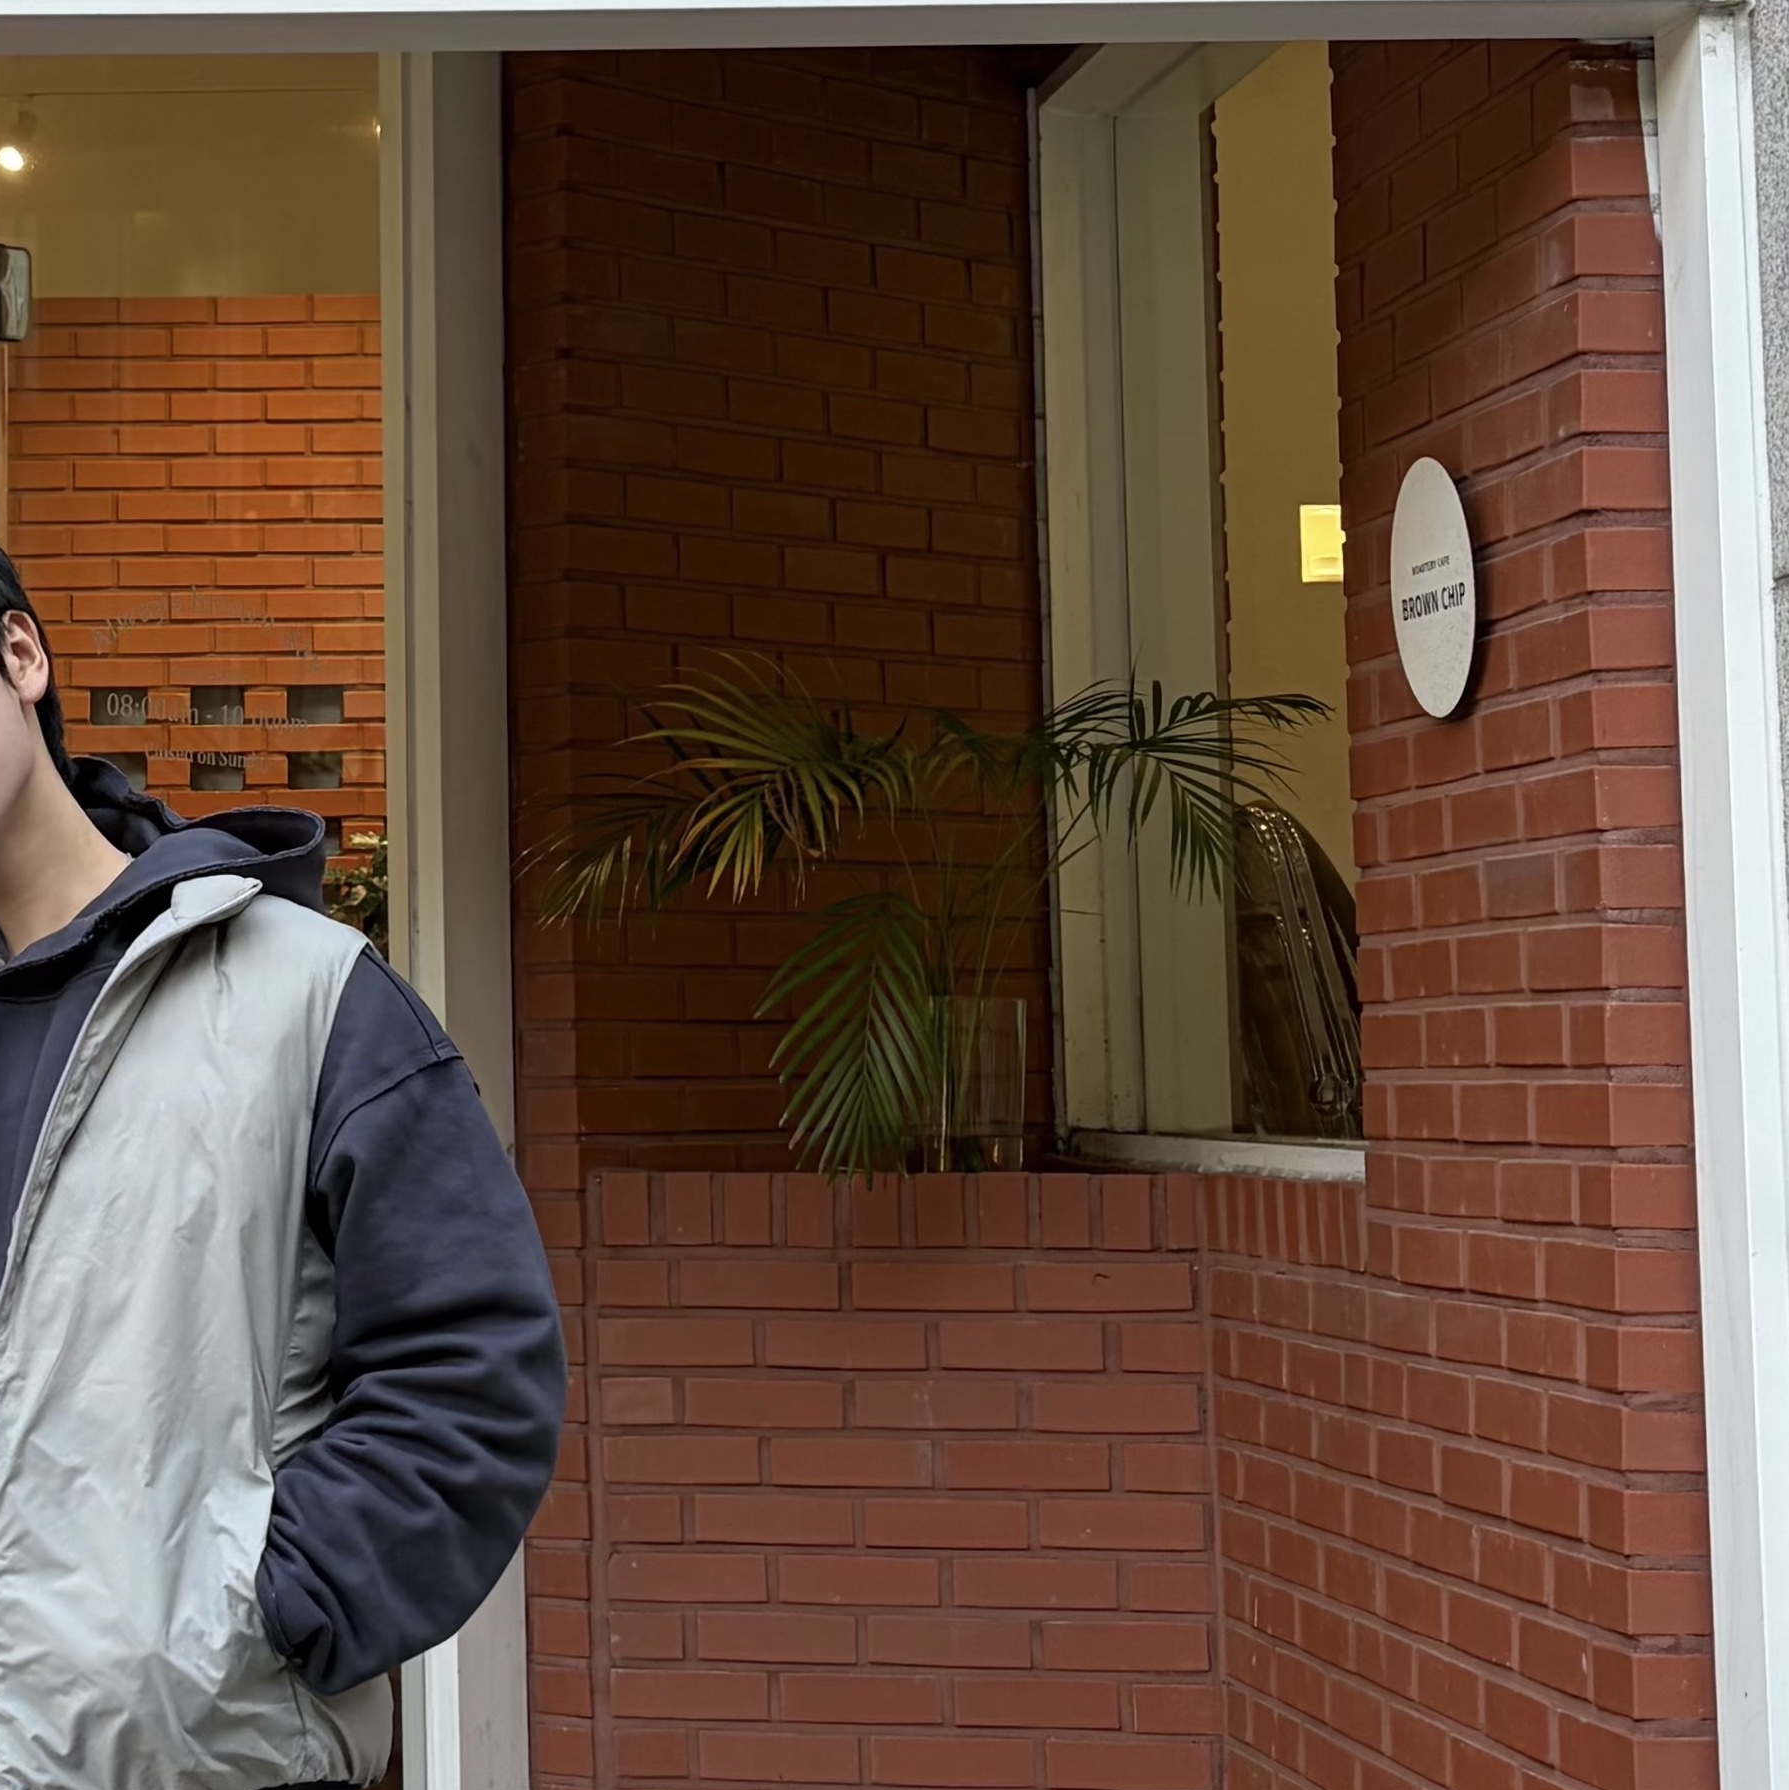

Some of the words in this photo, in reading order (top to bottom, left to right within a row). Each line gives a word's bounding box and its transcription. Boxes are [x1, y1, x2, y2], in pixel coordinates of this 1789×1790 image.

[1402, 589, 1439, 621] BROWN
[1441, 582, 1465, 610] CHIP
[197, 751, 217, 766] on
